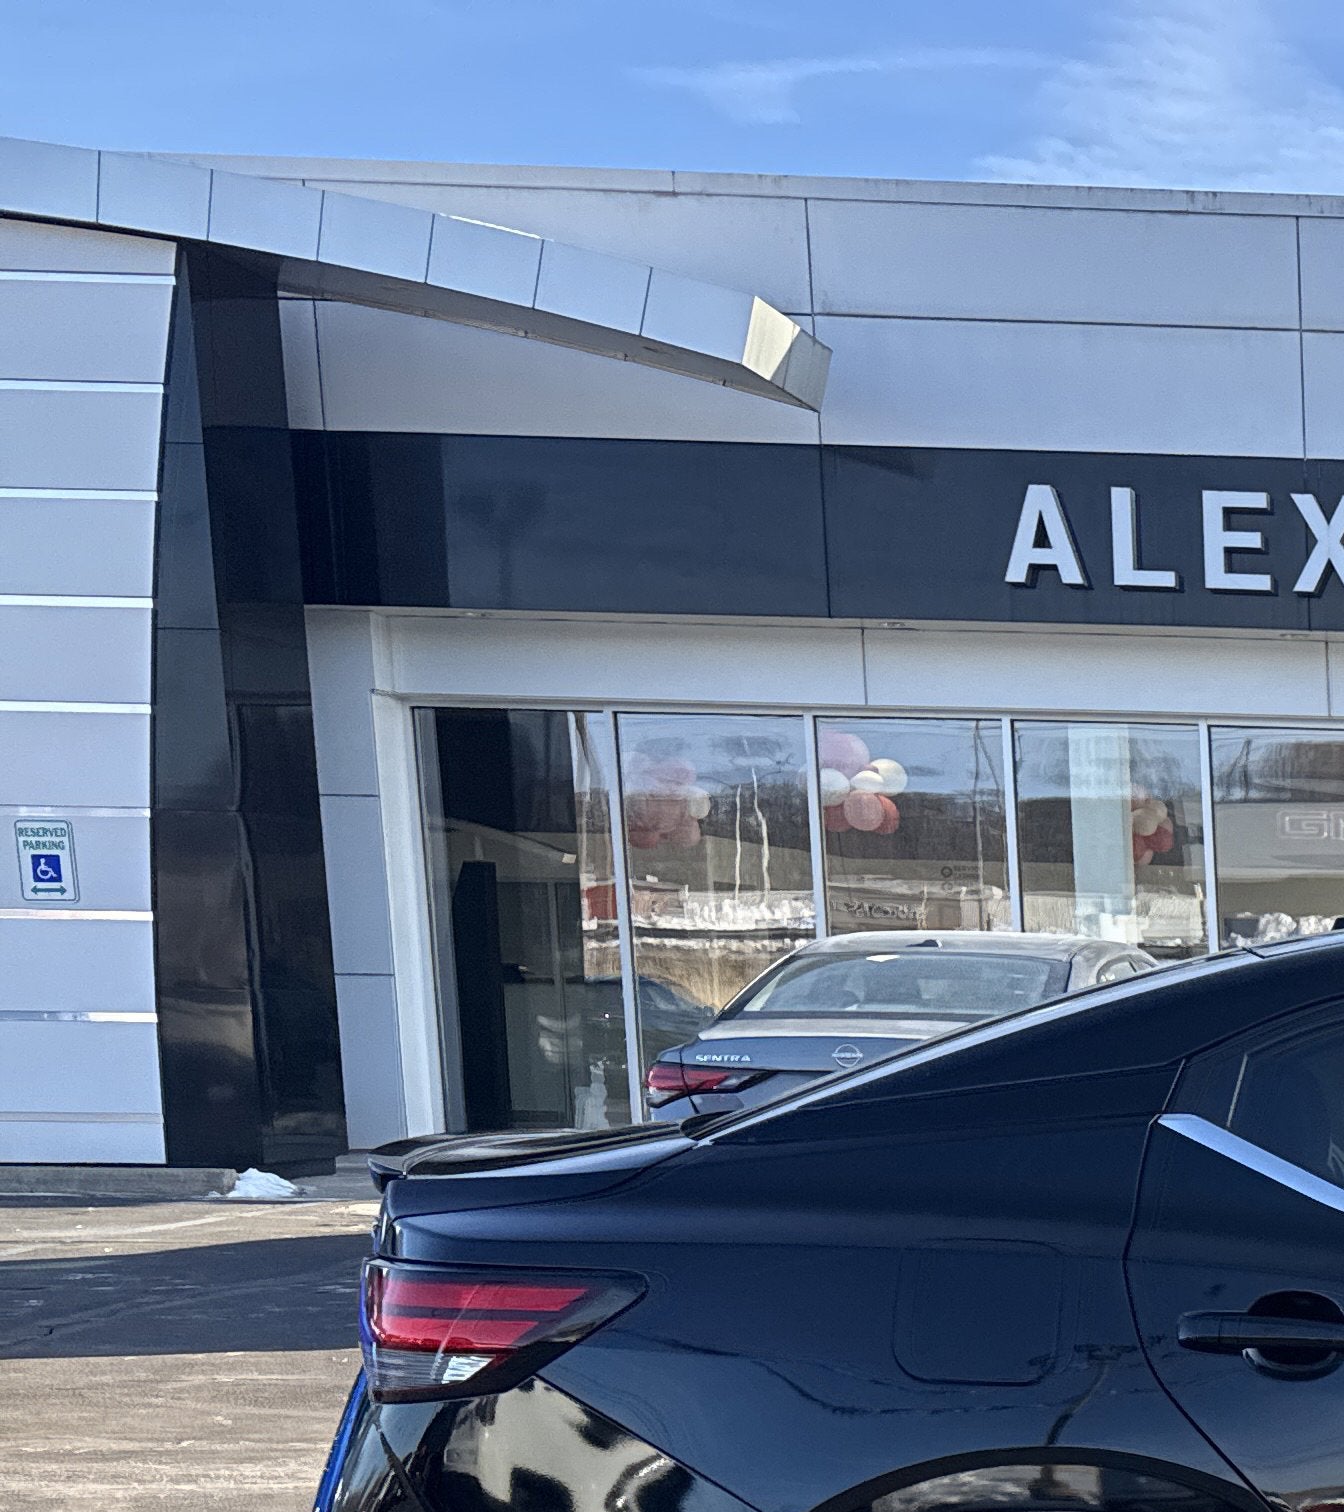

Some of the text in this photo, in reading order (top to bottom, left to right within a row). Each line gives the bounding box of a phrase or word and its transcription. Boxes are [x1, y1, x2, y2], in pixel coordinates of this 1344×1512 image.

[17, 827, 67, 838] RESERVED
[22, 839, 65, 851] PARKING
[695, 1054, 751, 1062] SENTRA
